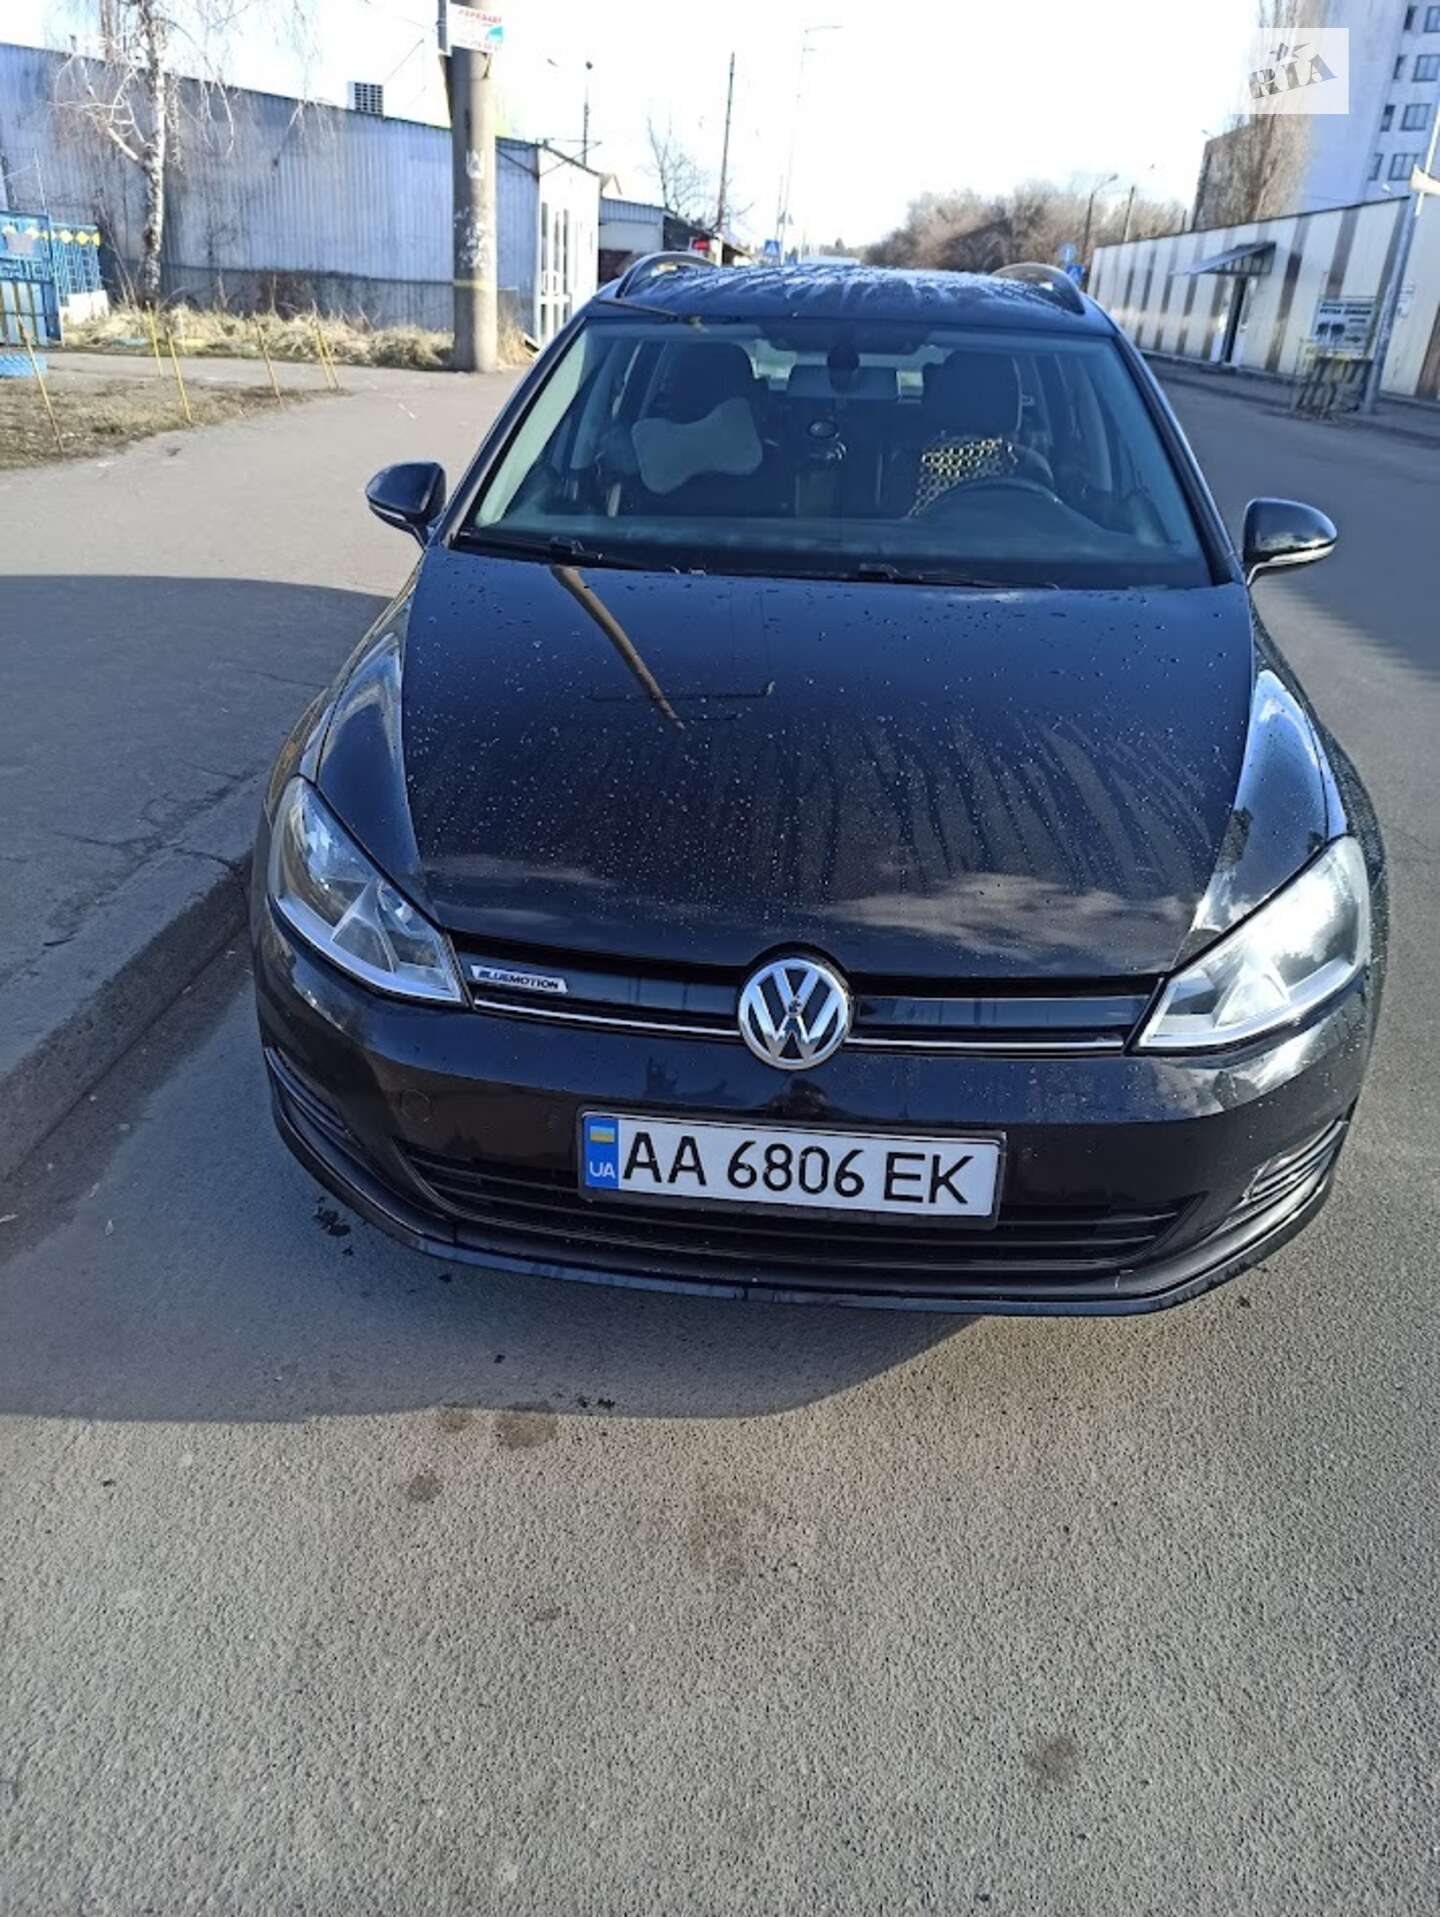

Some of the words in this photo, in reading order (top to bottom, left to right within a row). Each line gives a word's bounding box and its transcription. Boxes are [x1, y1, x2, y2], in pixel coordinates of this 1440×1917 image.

[478, 969, 559, 990] BLUEMOTION
[589, 1160, 617, 1180] UA
[622, 1131, 707, 1186] AA
[727, 1140, 865, 1199] 6806
[883, 1151, 974, 1204] EK
